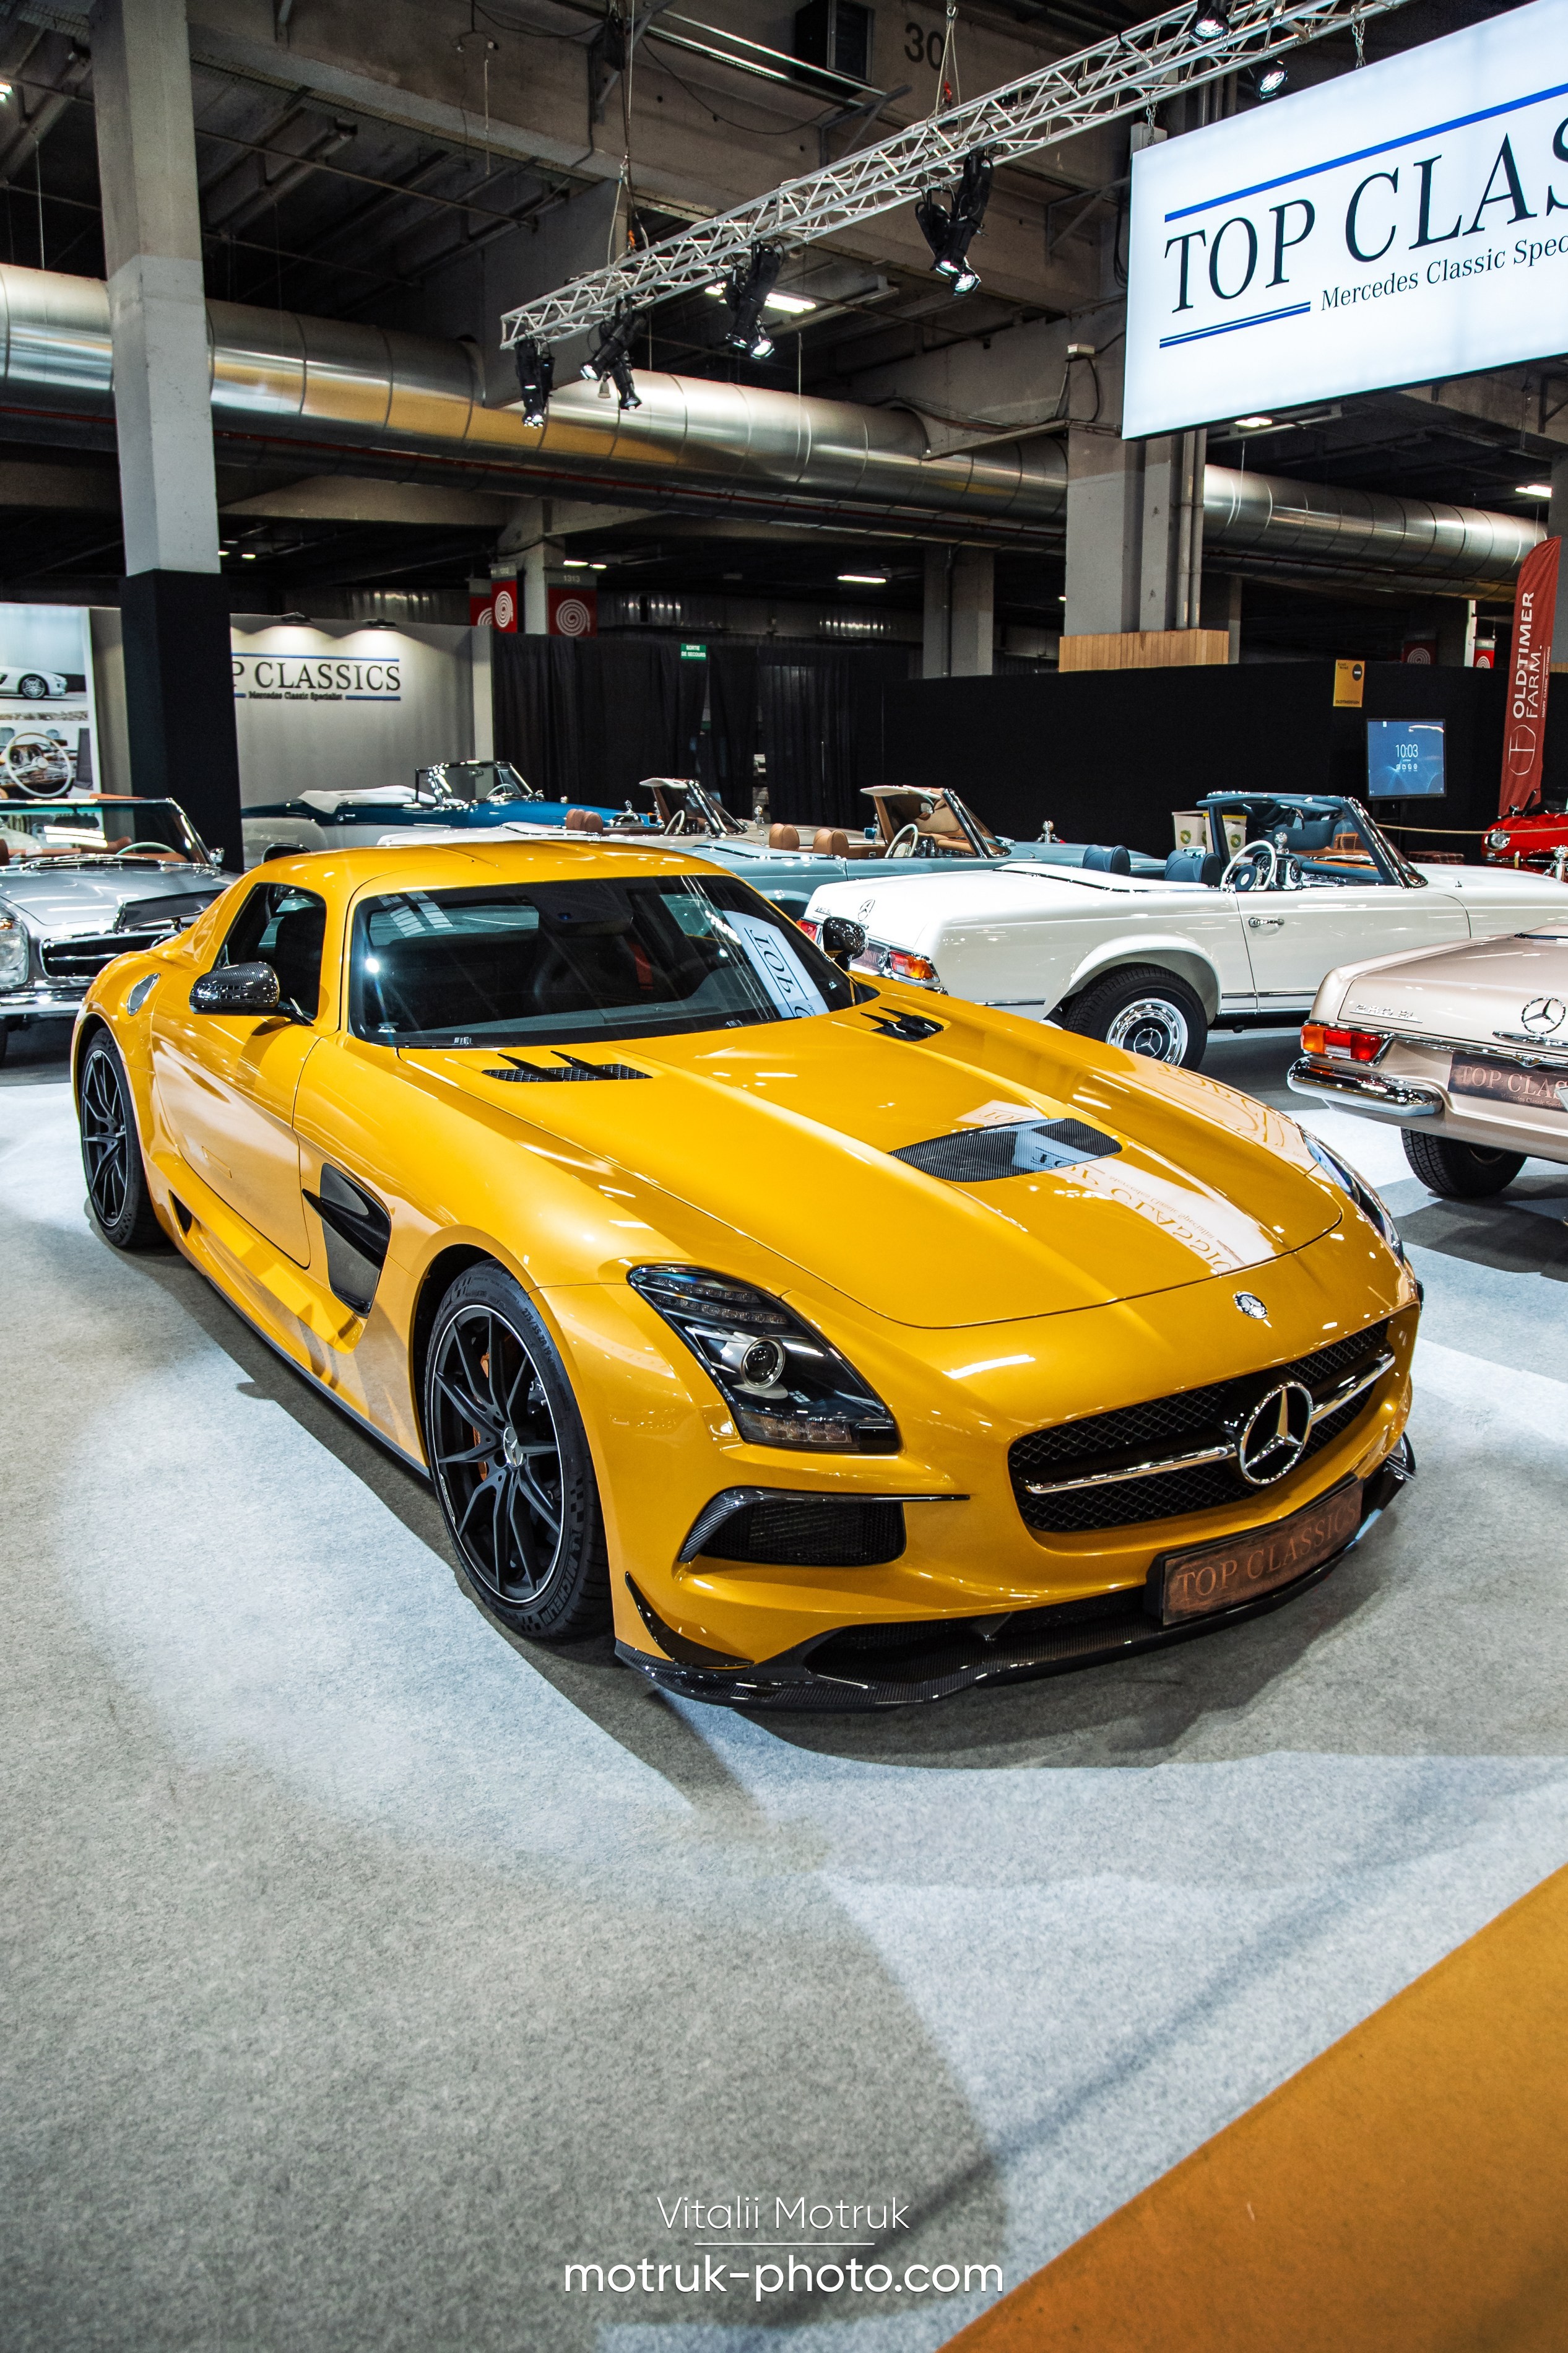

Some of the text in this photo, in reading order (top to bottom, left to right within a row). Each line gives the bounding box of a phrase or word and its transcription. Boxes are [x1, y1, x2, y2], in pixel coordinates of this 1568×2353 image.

[904, 22, 946, 71] 30
[1164, 199, 1315, 313] TOP
[1321, 272, 1419, 311] Mercedes
[1427, 248, 1506, 284] Classic
[563, 575, 581, 583] 1313
[254, 661, 401, 691] CLASSICS
[1513, 592, 1535, 719] OLDTIMER
[1395, 744, 1419, 758] 10:03
[1355, 1004, 1393, 1016] 280
[1461, 1066, 1502, 1089] TOP
[1176, 1560, 1237, 1602] TOP
[1247, 1498, 1356, 1578] CLASSICS
[537, 1552, 579, 1627] MICHELIN
